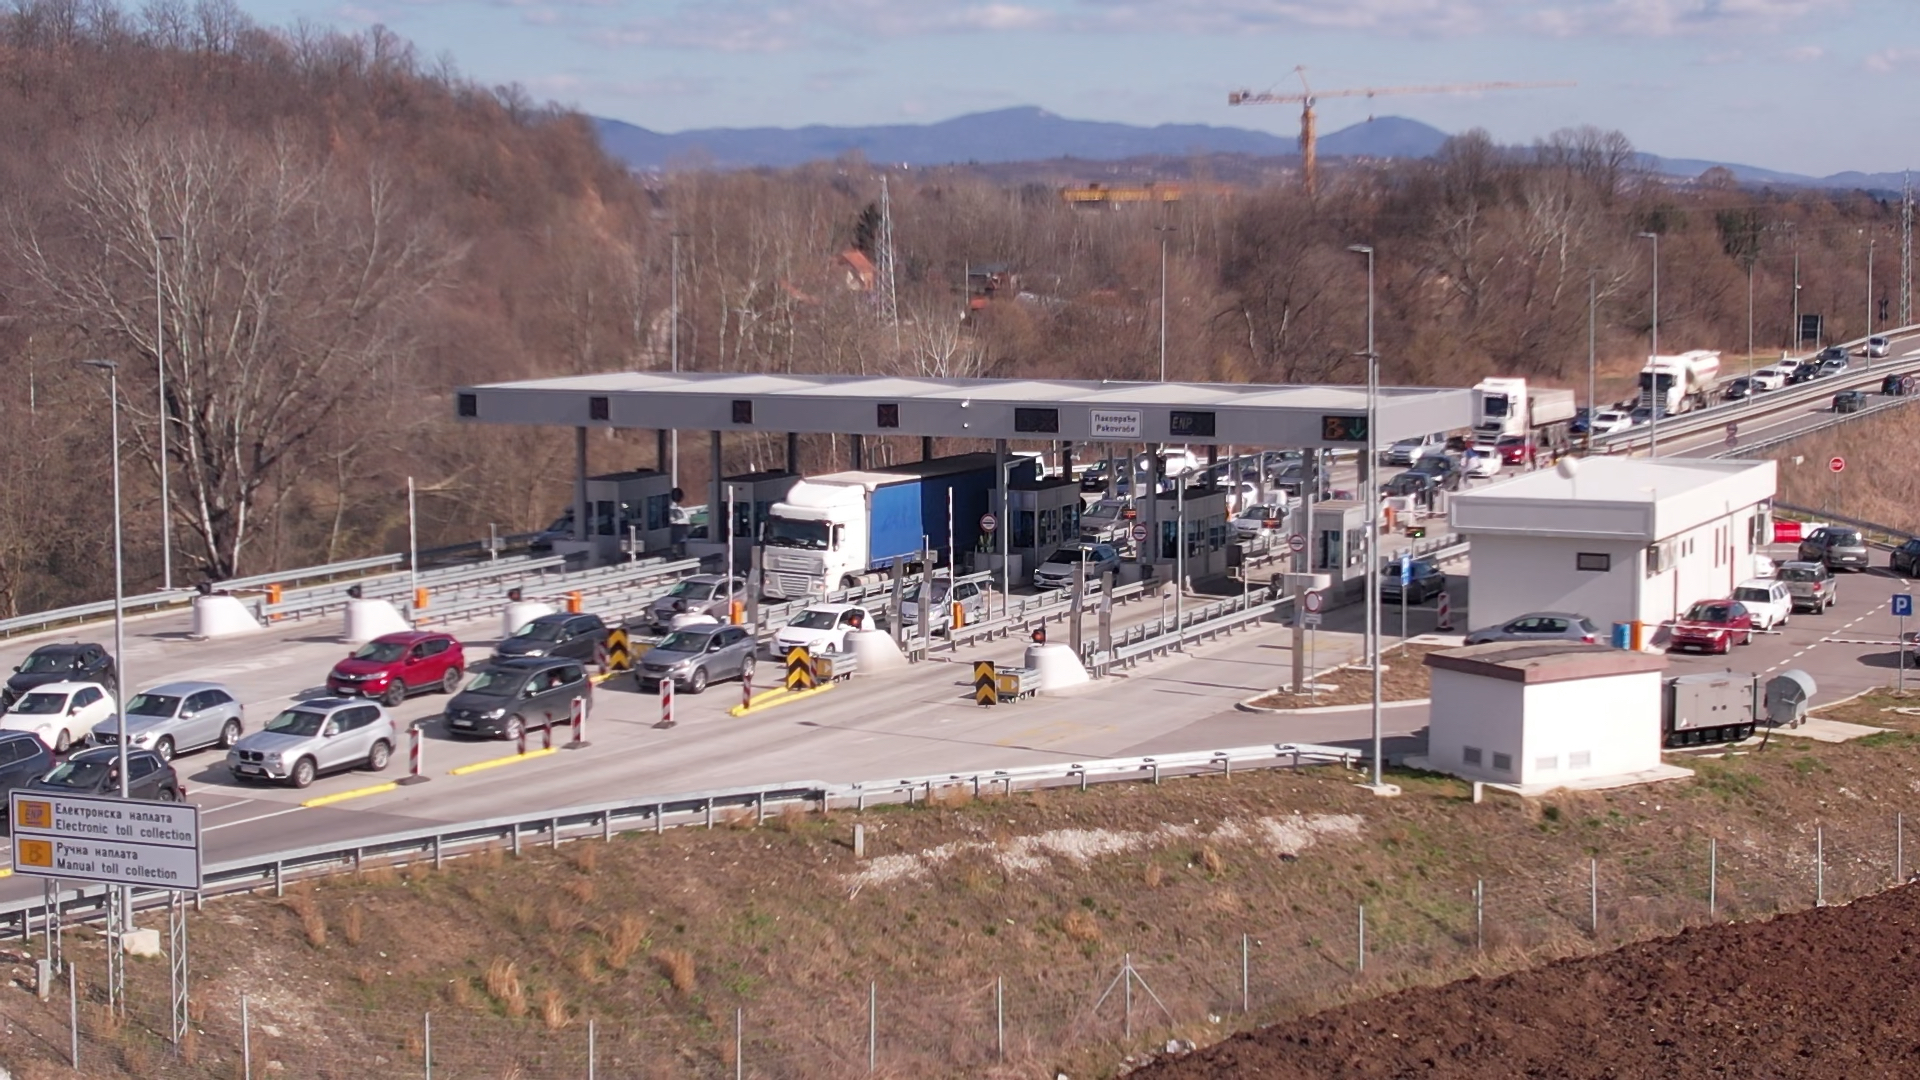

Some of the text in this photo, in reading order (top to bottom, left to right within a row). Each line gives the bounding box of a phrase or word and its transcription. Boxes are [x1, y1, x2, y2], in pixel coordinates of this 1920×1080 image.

[1896, 597, 1907, 613] P
[55, 803, 172, 823] Електронска наплата
[55, 819, 192, 841] Electronic toll collection
[56, 842, 138, 860] Ручна наплата
[56, 858, 177, 879] Manual toll collection
